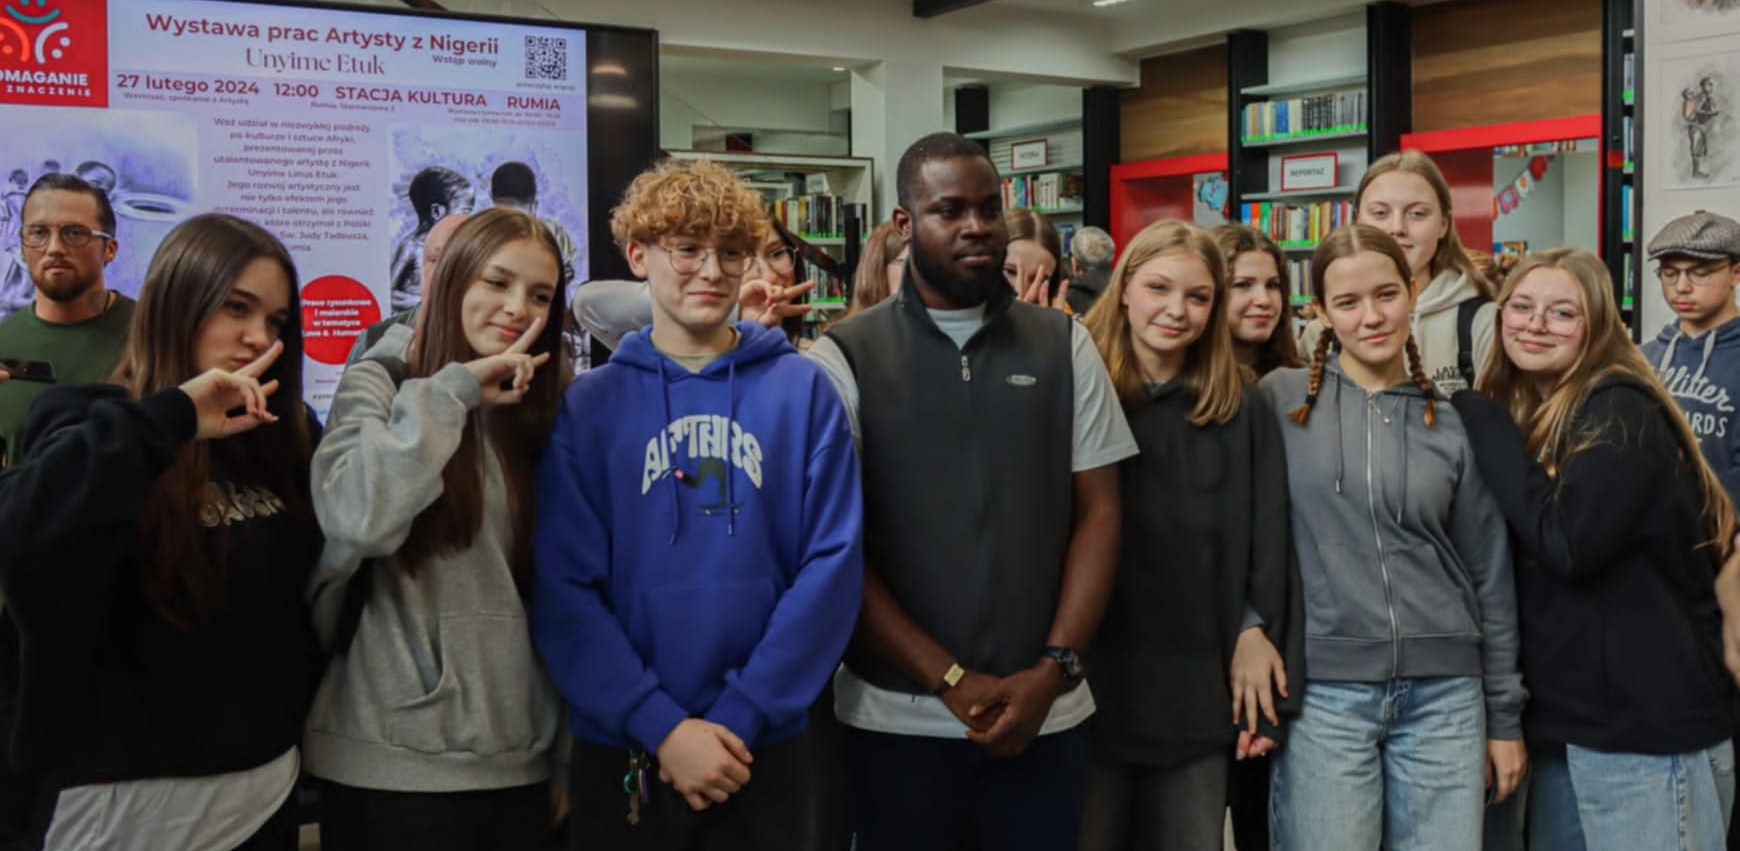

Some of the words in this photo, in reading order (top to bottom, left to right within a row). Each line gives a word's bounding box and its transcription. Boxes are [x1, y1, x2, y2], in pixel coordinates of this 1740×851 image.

[146, 13, 260, 38] Wystawa
[268, 25, 319, 43] prac
[326, 27, 406, 52] Artysty
[412, 35, 424, 49] z
[430, 35, 499, 56] Nigerii
[246, 48, 331, 73] Unyime
[337, 53, 385, 75] Etuk
[432, 54, 465, 67] Wstęp
[467, 57, 497, 69] wolny
[0, 70, 88, 86] MAGANIE
[6, 84, 91, 97] ZNACZENIE
[117, 73, 140, 89] 27
[146, 74, 209, 95] lutego
[214, 79, 260, 96] 2024
[273, 82, 319, 98] 12:00
[335, 86, 403, 103] STACJA
[408, 90, 487, 107] KULTURA
[507, 95, 561, 111] RUMIA
[238, 118, 268, 128] udział
[245, 132, 285, 141] kulturze
[293, 133, 323, 142] sztuce
[244, 144, 316, 156] prezentowanej
[318, 147, 343, 156] przez
[213, 155, 294, 167] utalentowanego
[248, 169, 285, 179] Unyime
[288, 170, 313, 179] Linus
[227, 181, 250, 192] Jego
[252, 181, 286, 192] rozwój
[288, 182, 341, 193] artystyczny
[343, 183, 360, 193] jest
[258, 194, 282, 204] tylko
[285, 195, 325, 203] efektem
[326, 196, 347, 205] jego
[322, 207, 336, 215] ale
[300, 231, 321, 241] Judy
